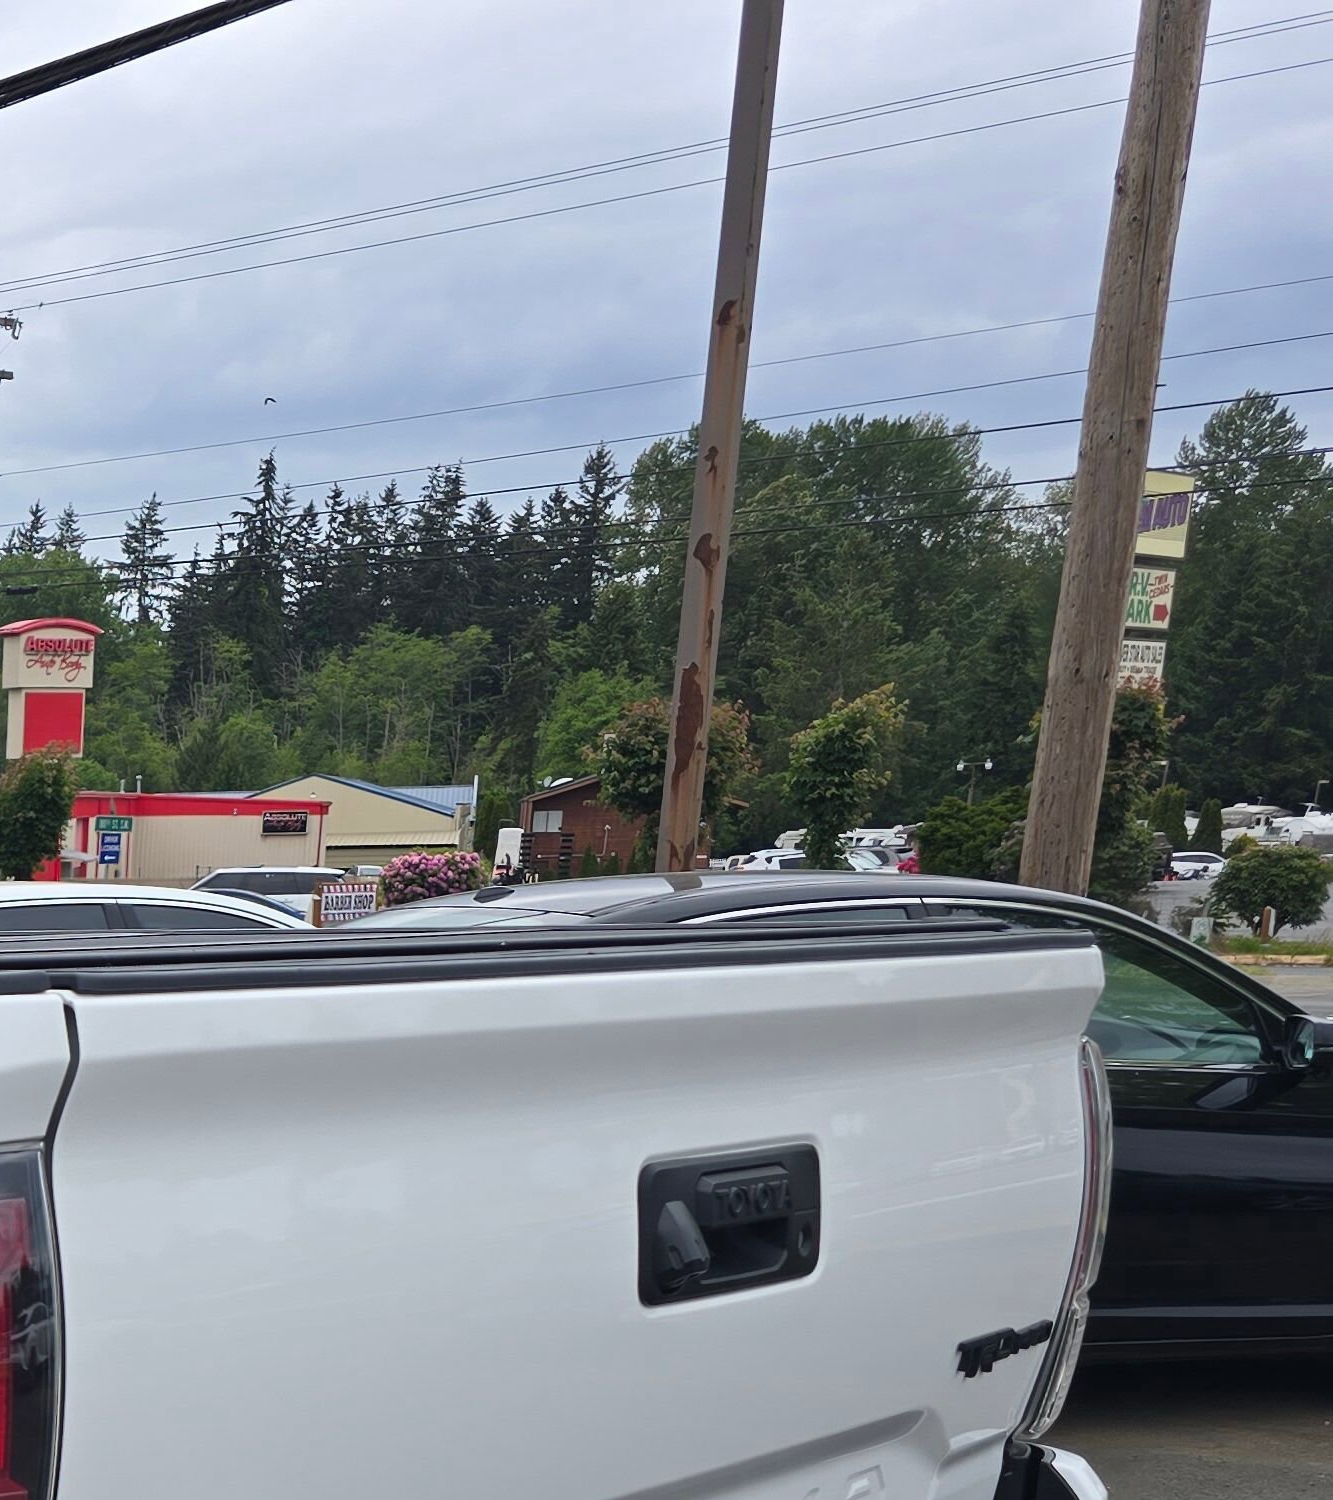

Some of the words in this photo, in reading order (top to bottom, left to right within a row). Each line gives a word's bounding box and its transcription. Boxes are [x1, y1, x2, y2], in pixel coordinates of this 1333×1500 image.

[1126, 598, 1152, 624] ARK
[23, 636, 95, 653] ABSOLUTE
[324, 895, 352, 911] BARBER
[353, 894, 374, 910] SHOP
[714, 1179, 791, 1219] TOYOTA
